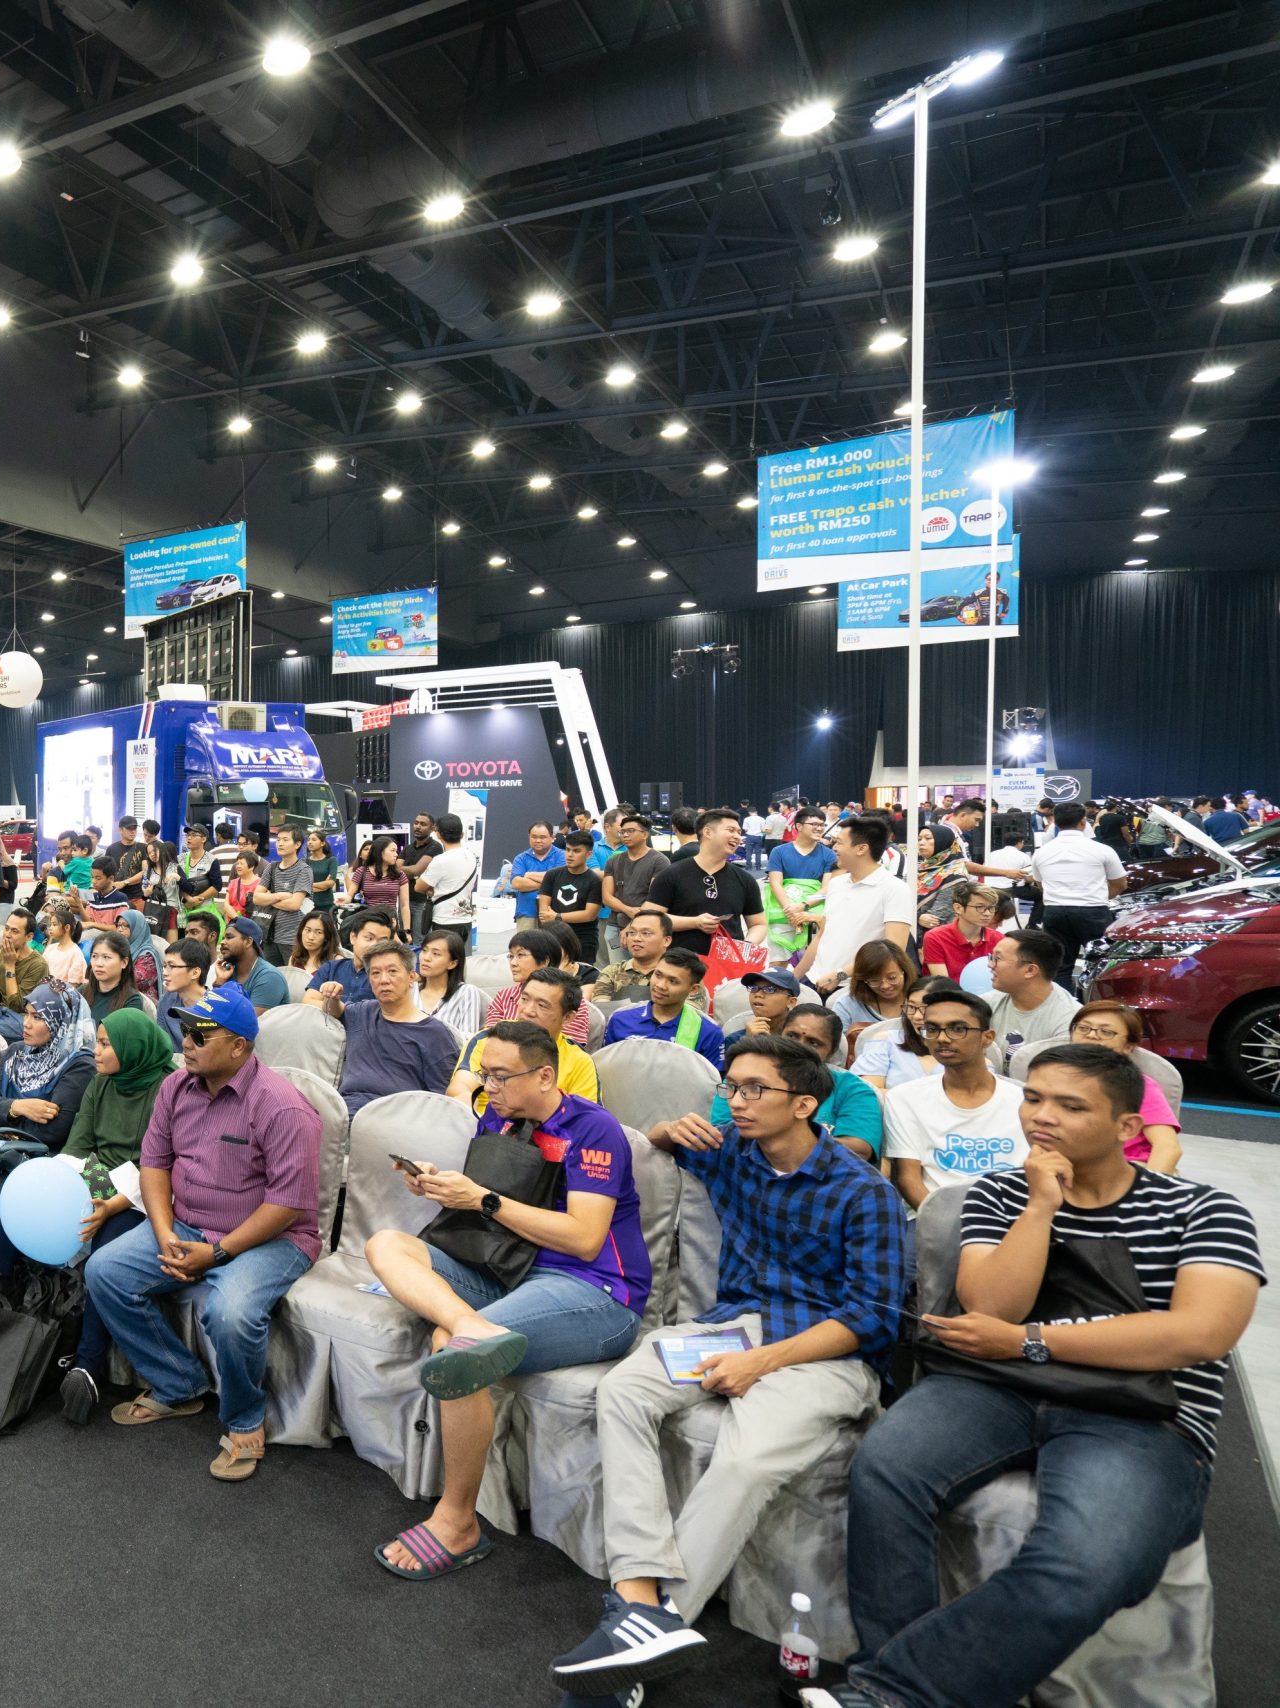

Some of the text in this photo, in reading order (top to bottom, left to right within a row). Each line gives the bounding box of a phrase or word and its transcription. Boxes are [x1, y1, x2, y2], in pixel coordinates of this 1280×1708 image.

[770, 449, 872, 476] Free RM1,000
[770, 472, 824, 488] Llumar
[826, 464, 862, 478] cash
[770, 495, 784, 504] for
[786, 491, 806, 502] first
[816, 480, 874, 495] on-the-spot
[876, 477, 894, 486] car
[896, 468, 944, 482] boings
[770, 511, 807, 526] FREE
[811, 506, 855, 520] Trapo
[858, 498, 894, 512] cash
[770, 514, 871, 538] worth RM250
[922, 524, 950, 534] Lumar
[130, 534, 240, 560] Looking for pre-owned cars?
[770, 545, 784, 555] for
[786, 542, 806, 552] first
[822, 537, 844, 546] loan
[846, 528, 897, 542] approvals
[861, 582, 880, 590] Car
[882, 578, 908, 588] Park
[338, 604, 356, 613] Check
[383, 599, 404, 608] Angry
[352, 609, 384, 619] Activities
[446, 760, 522, 776] TOYOTA
[948, 1136, 1013, 1152] Peace
[581, 1148, 612, 1166] WU
[580, 1162, 610, 1174] Western
[588, 1170, 610, 1180] Union
